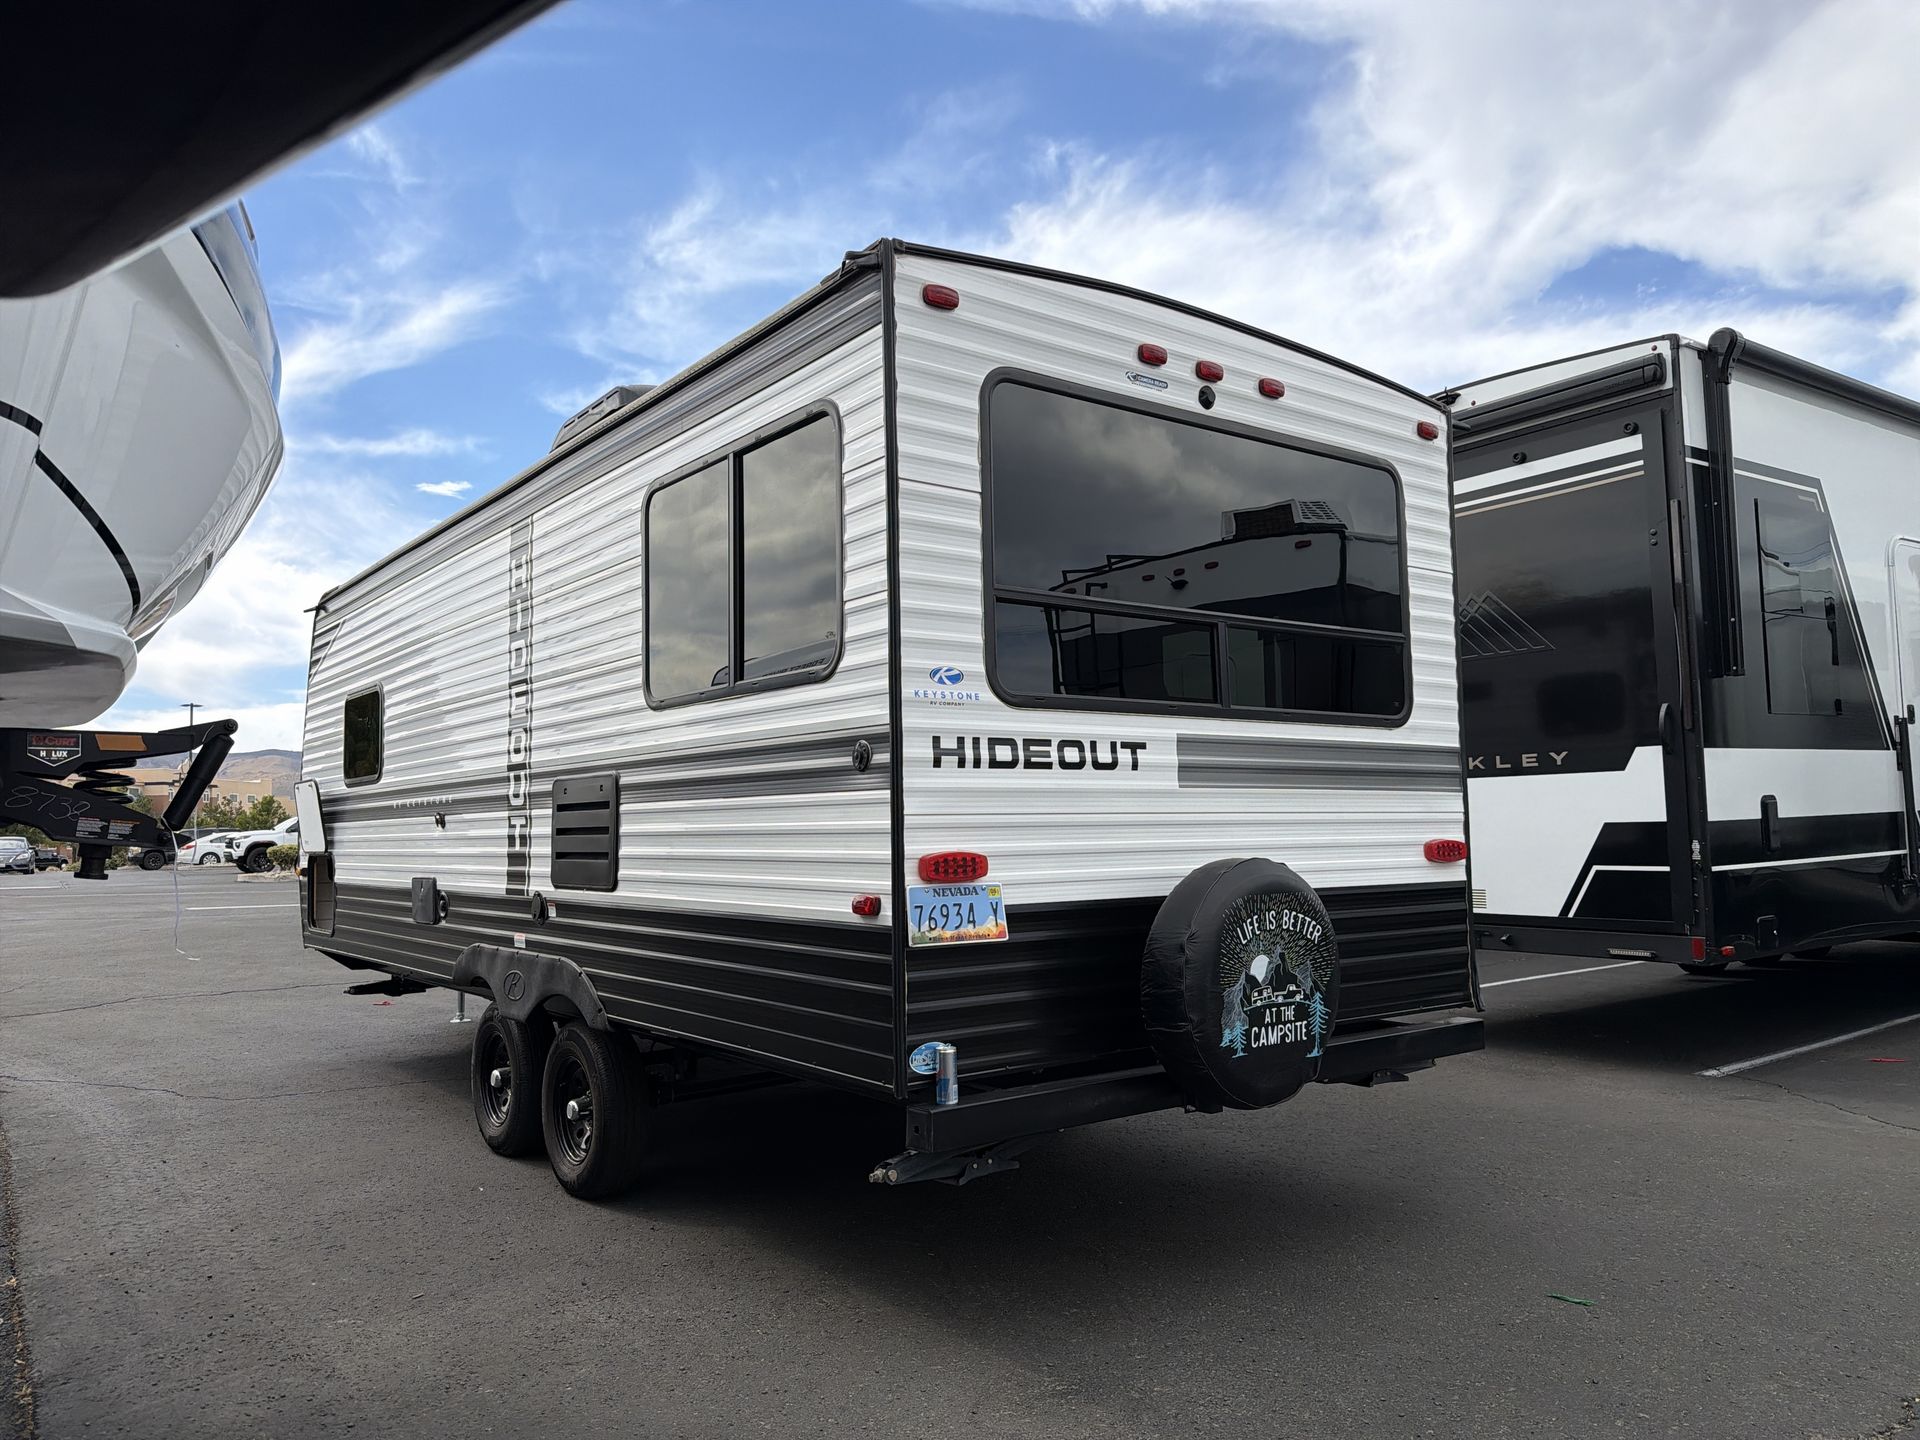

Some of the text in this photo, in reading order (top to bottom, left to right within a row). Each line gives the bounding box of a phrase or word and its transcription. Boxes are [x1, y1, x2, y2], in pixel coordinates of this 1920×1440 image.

[510, 553, 527, 850] HIDEOUT
[914, 689, 980, 700] KEYSTONE
[931, 735, 1147, 771] HIDEOUT
[1467, 751, 1569, 770] KLEY
[932, 886, 979, 897] NEVADA
[914, 901, 999, 932] 76934 Y
[1237, 909, 1322, 944] LIFE IS BETTER
[1264, 1005, 1295, 1024] AT THE
[1251, 1020, 1308, 1048] CAMPSITE
